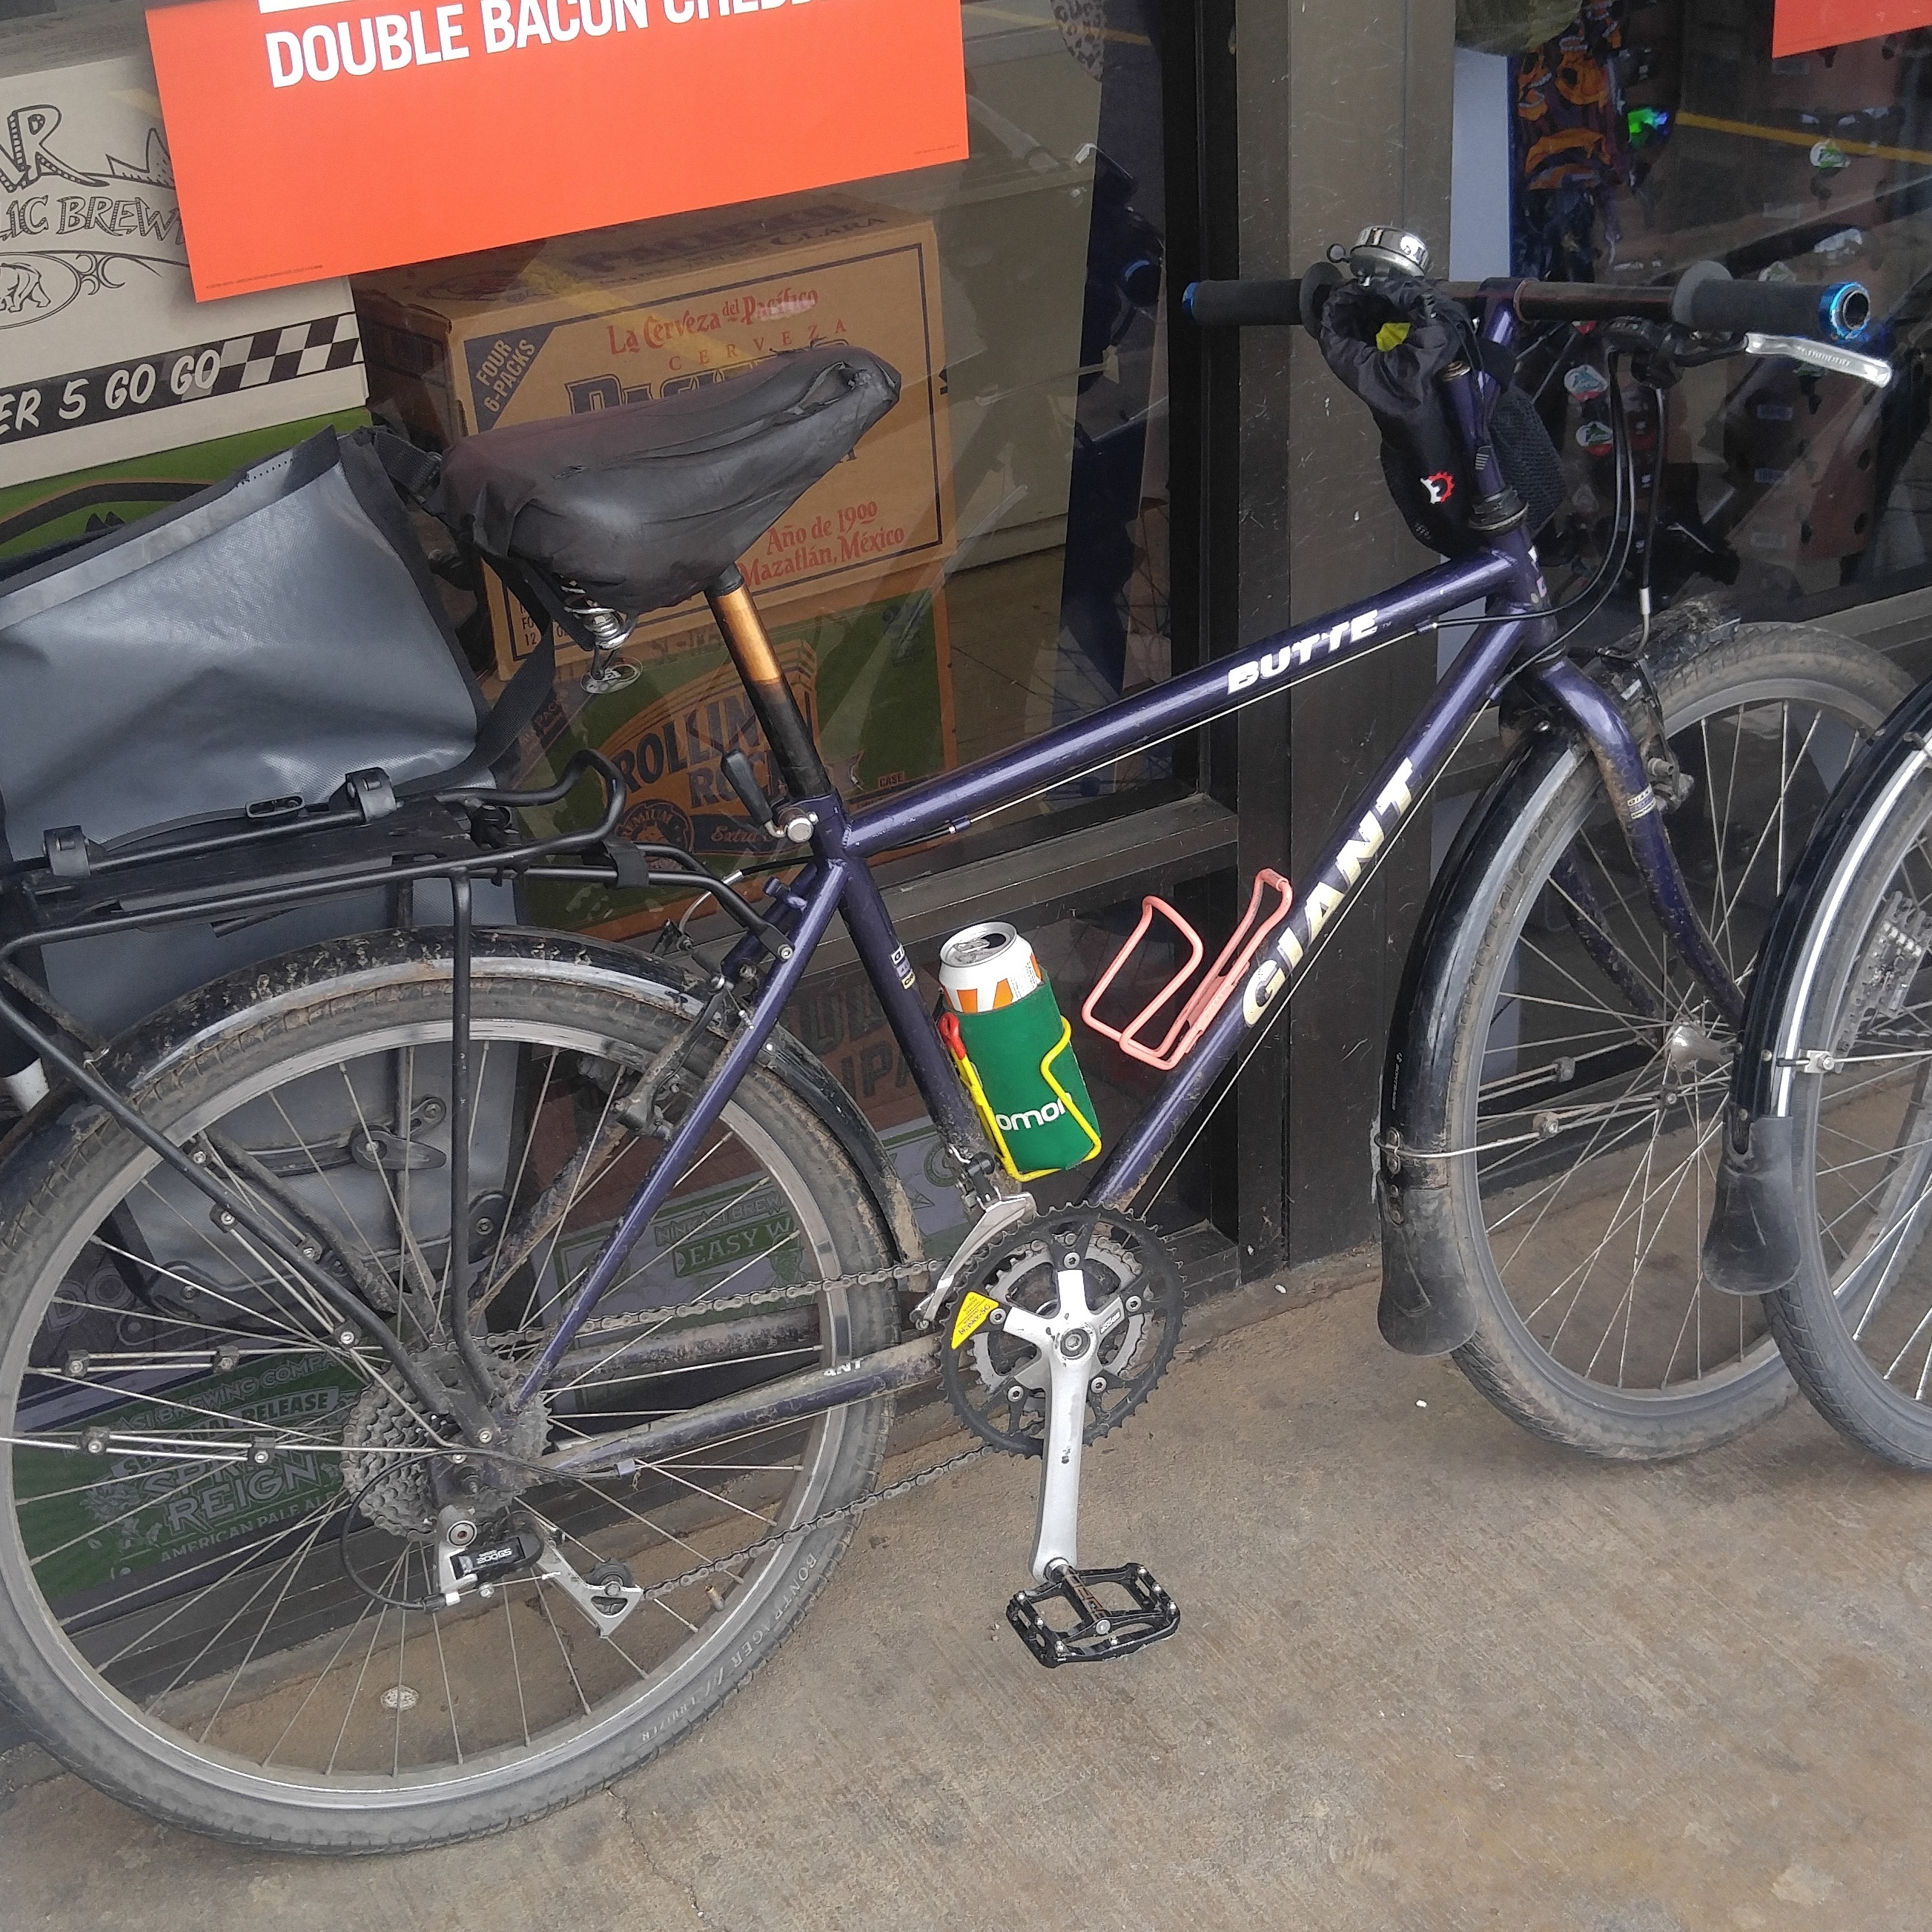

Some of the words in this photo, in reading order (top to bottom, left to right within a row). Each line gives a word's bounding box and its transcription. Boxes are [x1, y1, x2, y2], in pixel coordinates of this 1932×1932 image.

[265, 3, 470, 88] DOUBLE
[480, 0, 649, 54] BACON
[603, 324, 640, 354] La
[644, 310, 721, 349] Cerveza
[722, 298, 740, 322] del
[669, 319, 847, 371] CERVEZA
[59, 378, 90, 420] 5
[105, 363, 156, 410] GO
[171, 349, 221, 395] GO
[475, 339, 512, 387] FOUR
[483, 338, 535, 412] 6-PACKS
[766, 525, 807, 556] Año
[810, 515, 833, 540] de
[836, 500, 879, 535] 1900
[837, 526, 905, 563] México
[1227, 609, 1379, 695] BUTTE
[1242, 756, 1413, 1028] GIANT
[730, 1190, 783, 1224] BREW
[688, 1227, 758, 1266] EASY
[261, 1352, 340, 1389] COMPA
[165, 1450, 322, 1536] REIGN
[160, 1521, 254, 1563] AMERICAN
[259, 1503, 302, 1529] PALE
